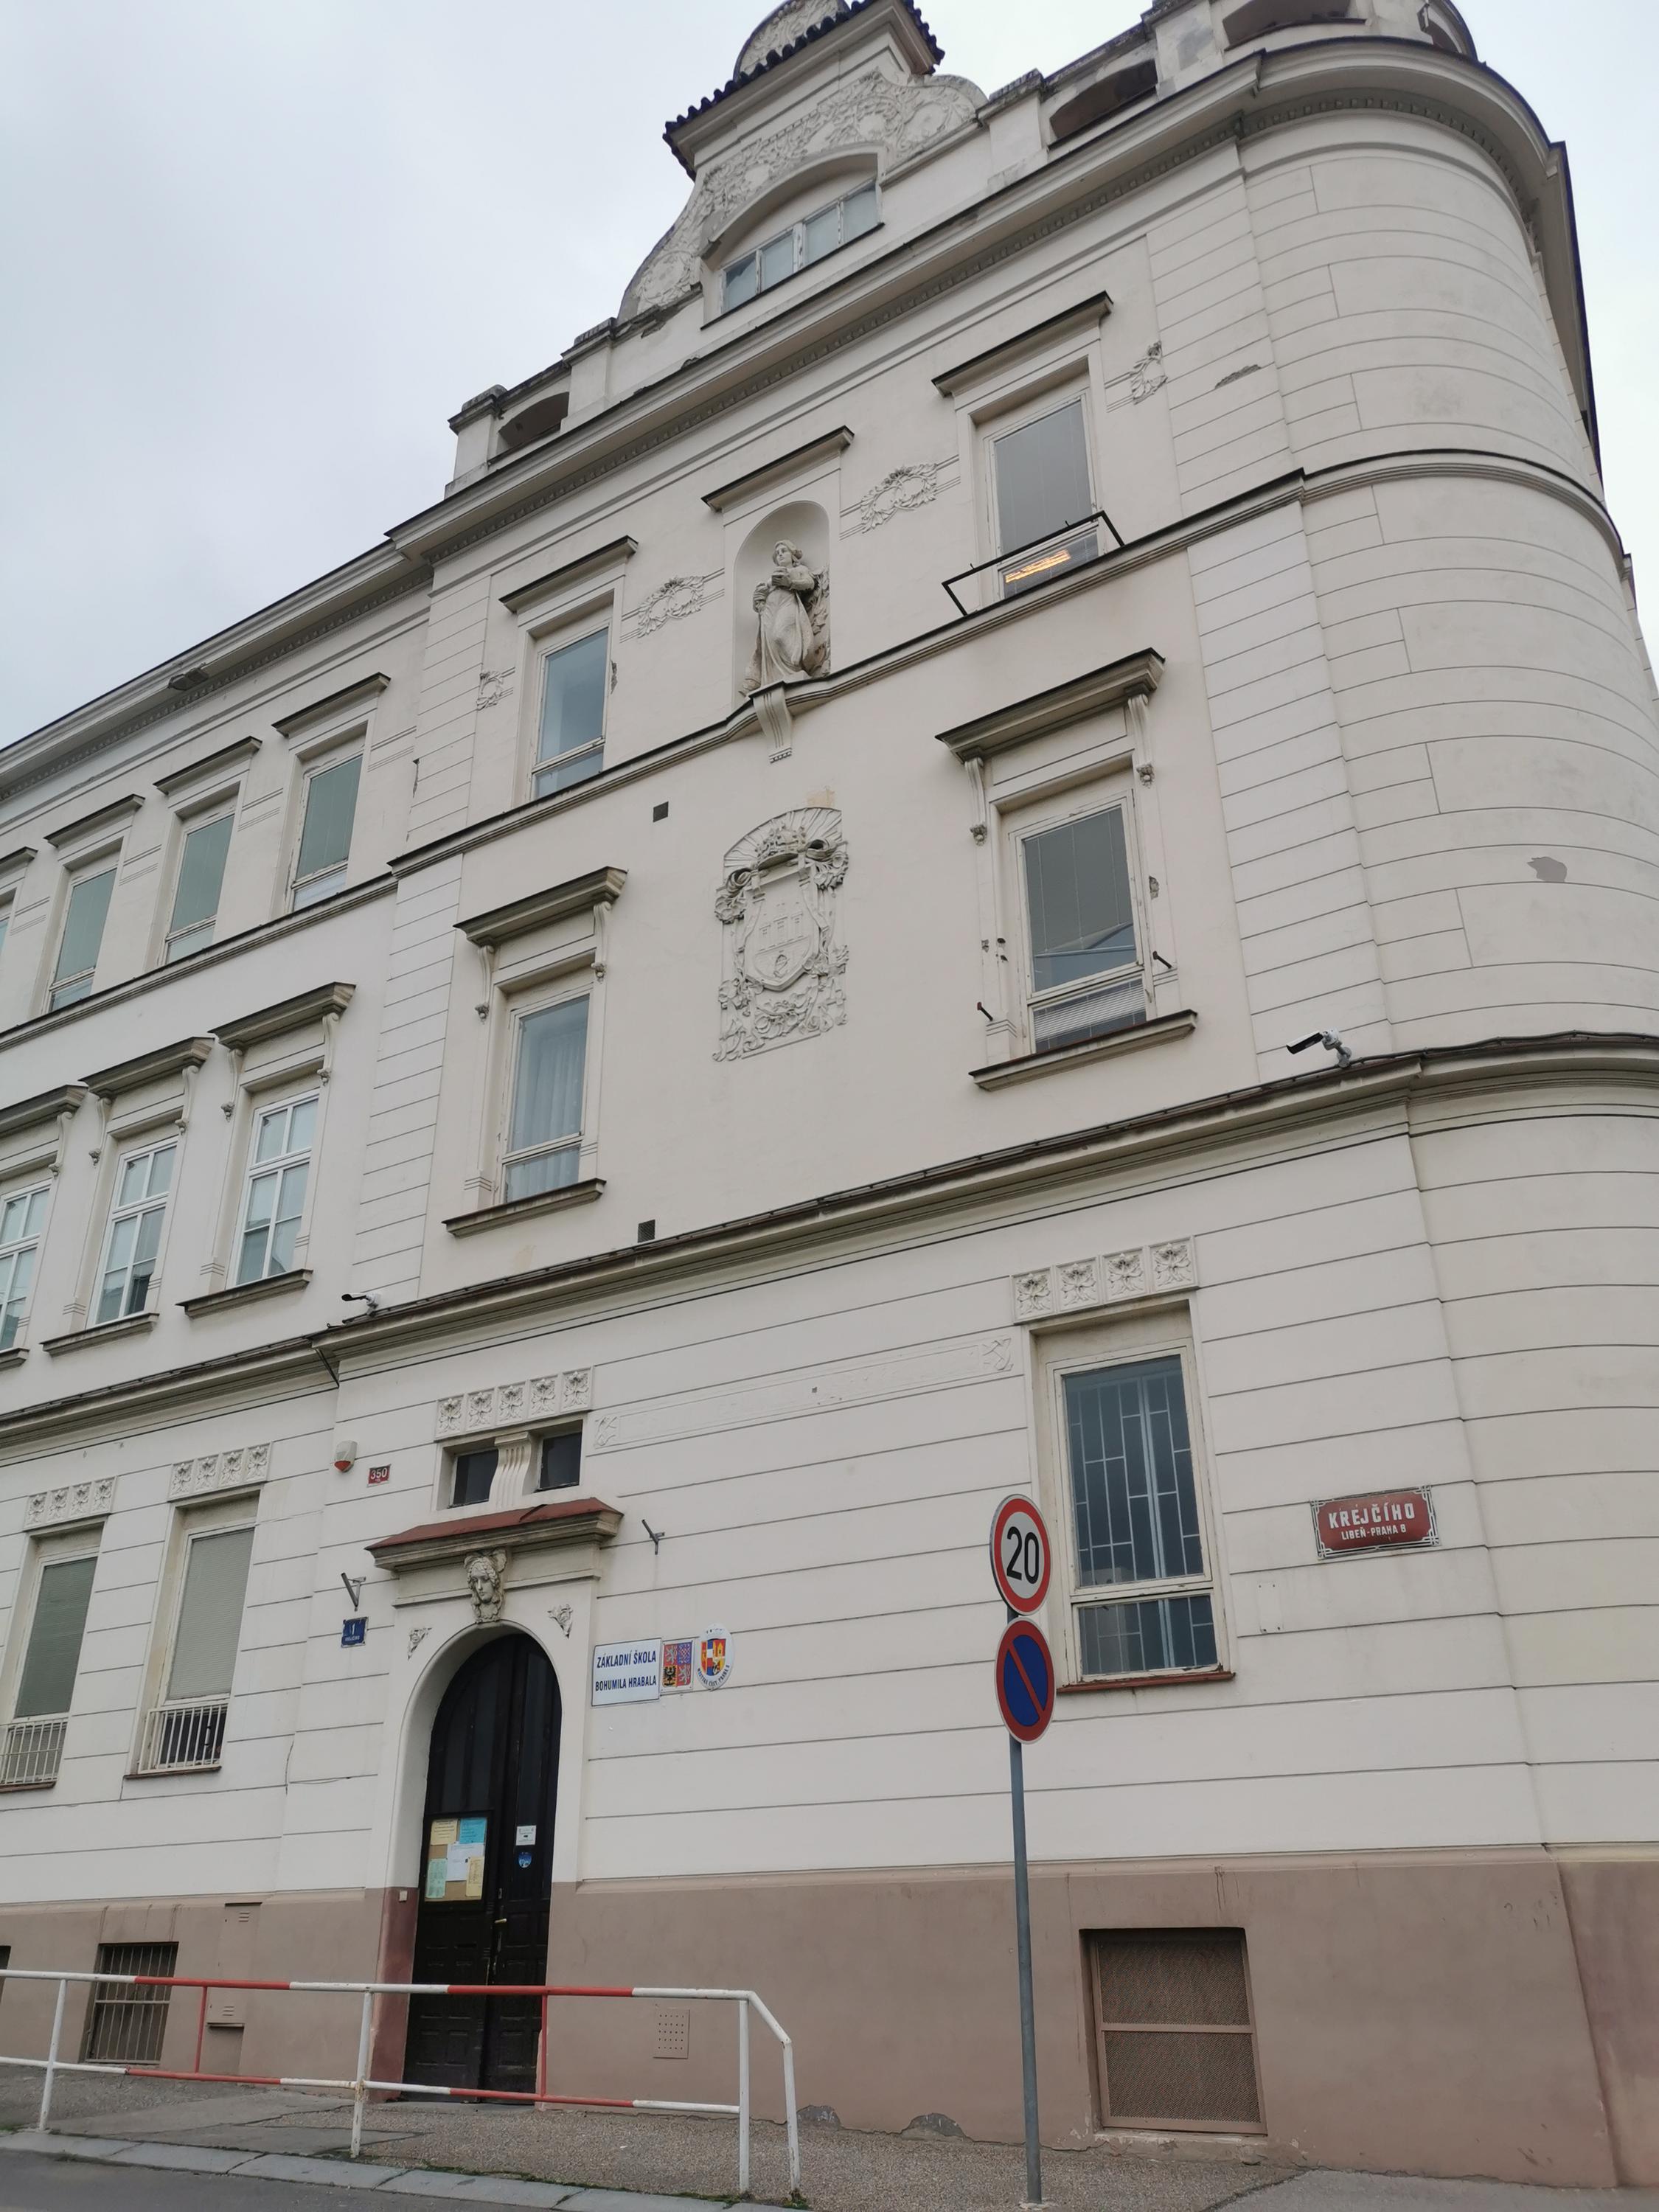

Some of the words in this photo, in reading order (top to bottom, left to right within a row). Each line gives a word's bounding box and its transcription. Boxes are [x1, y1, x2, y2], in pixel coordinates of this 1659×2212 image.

[371, 1468, 387, 1480] 350
[1329, 1503, 1415, 1528] KREJČÍHO
[1400, 1524, 1406, 1533] 8
[1006, 1526, 1039, 1585] 20
[597, 1650, 631, 1669] ZÁKLADNÍ
[634, 1649, 656, 1664] ŠKOLA
[595, 1677, 627, 1692] BOHUMILA
[628, 1675, 656, 1688] HRABALA
